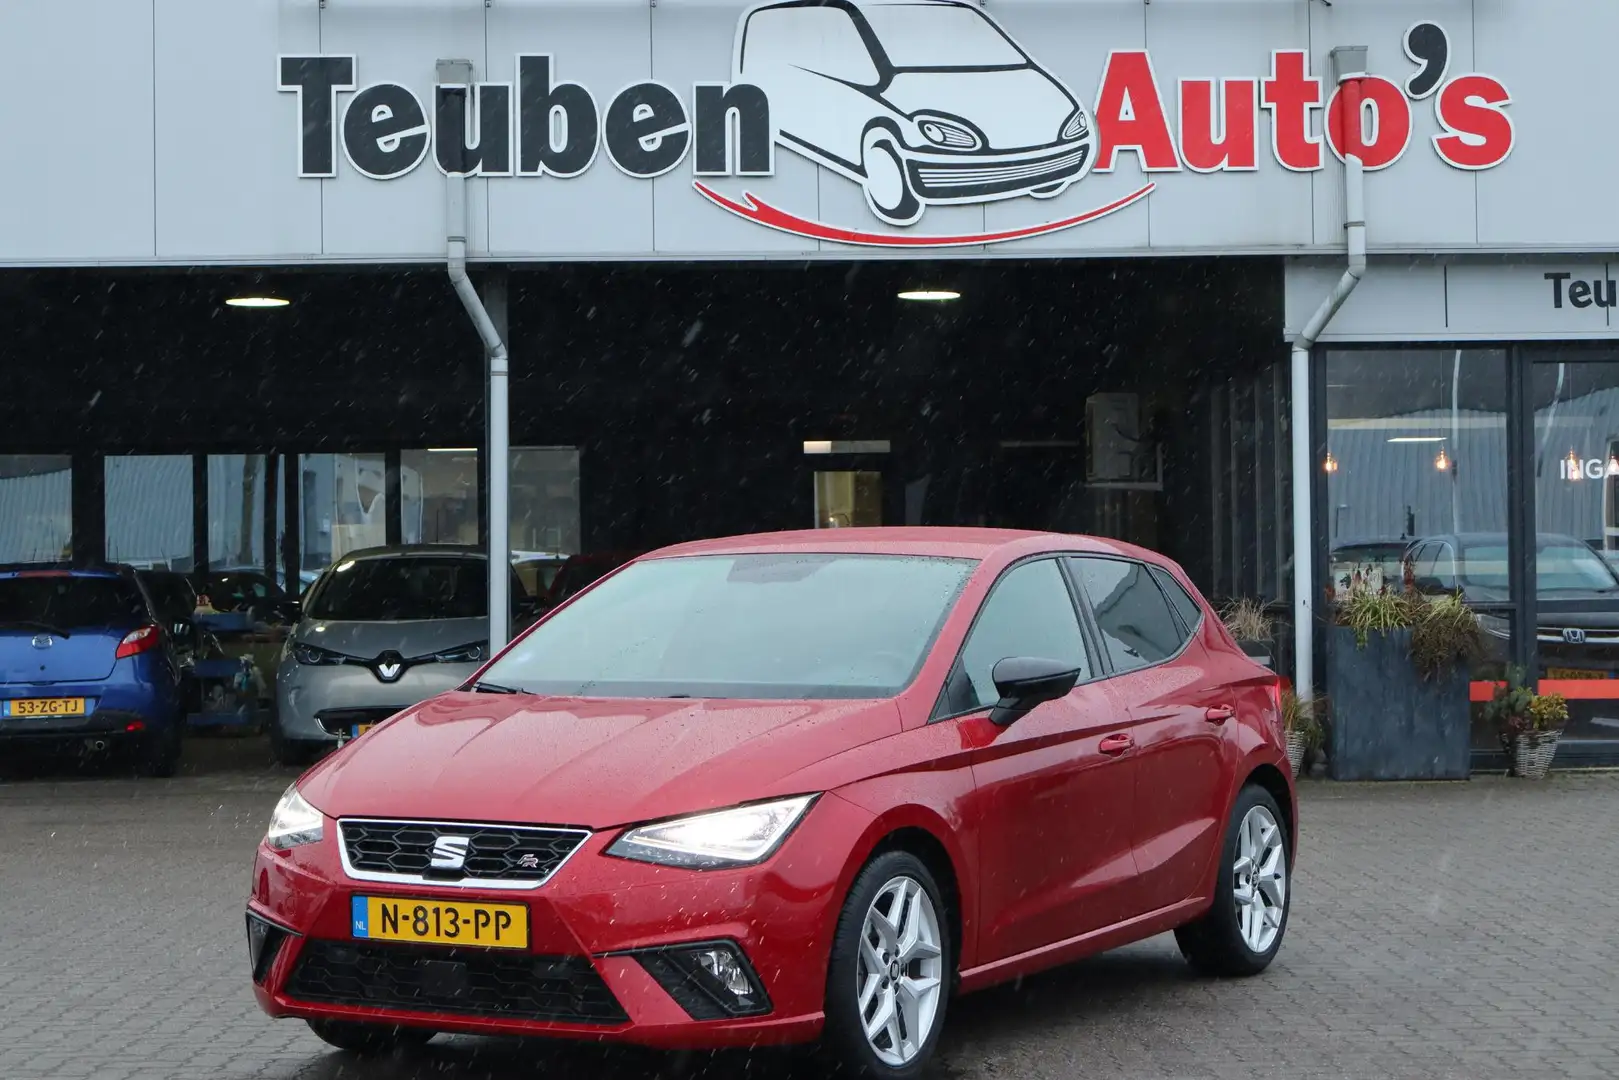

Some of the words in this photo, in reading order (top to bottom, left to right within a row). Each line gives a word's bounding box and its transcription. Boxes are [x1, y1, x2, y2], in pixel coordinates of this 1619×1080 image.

[279, 54, 772, 179] Teuben
[1094, 21, 1514, 172] Auto's
[1543, 272, 1617, 309] Teu
[17, 699, 79, 714] 53-ZG-TJ
[355, 920, 367, 931] NL
[380, 903, 512, 941] N-813-PP
